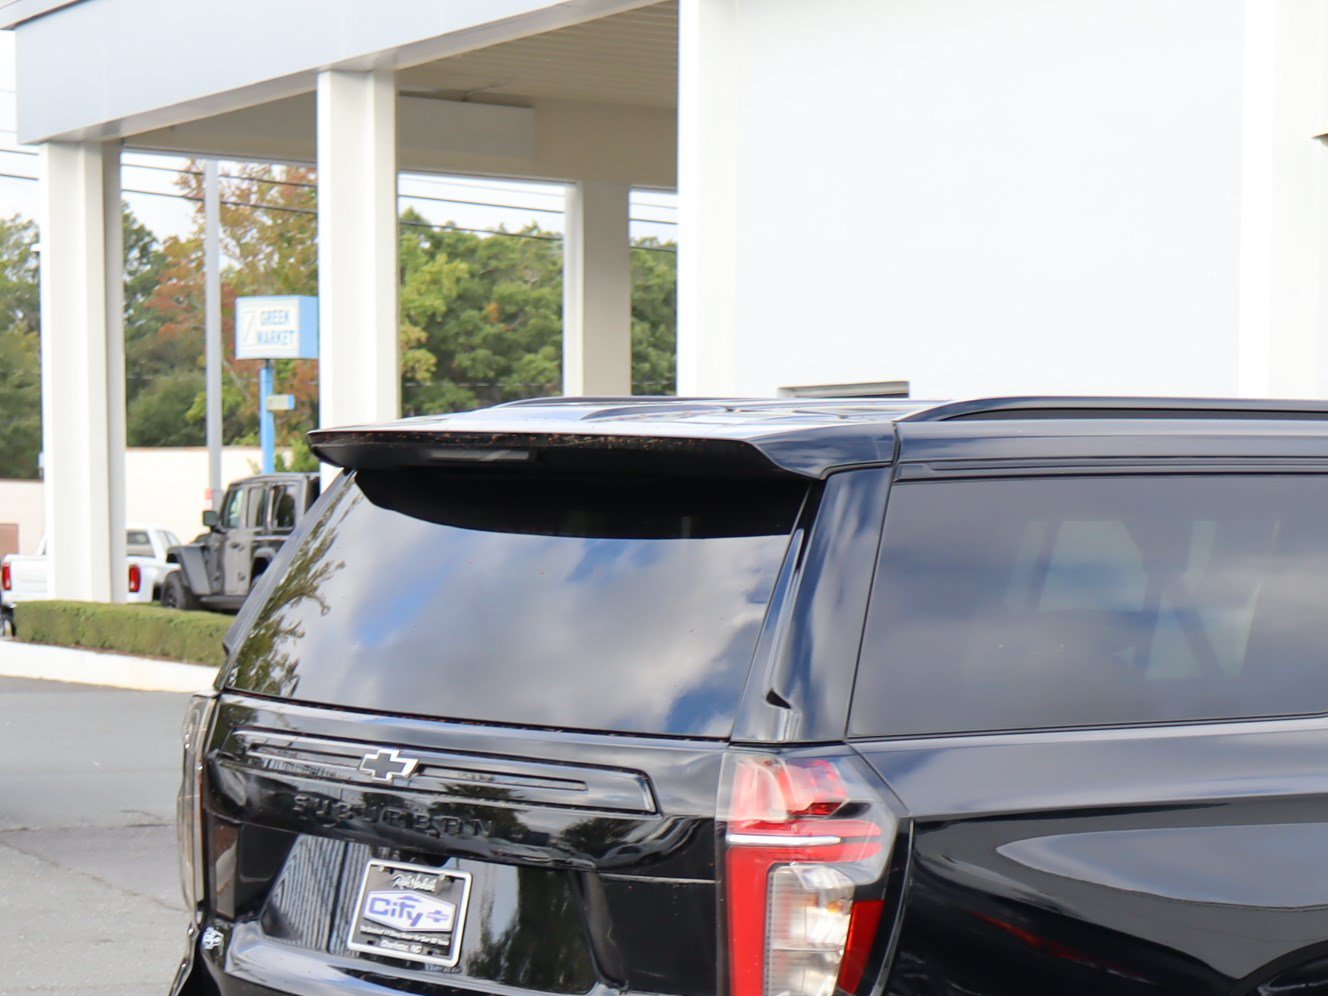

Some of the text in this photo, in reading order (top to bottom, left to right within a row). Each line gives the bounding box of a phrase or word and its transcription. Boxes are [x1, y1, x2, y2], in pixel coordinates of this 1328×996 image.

[257, 329, 296, 346] MARKET
[292, 793, 494, 838] SUBURBAN
[369, 897, 423, 927] City
